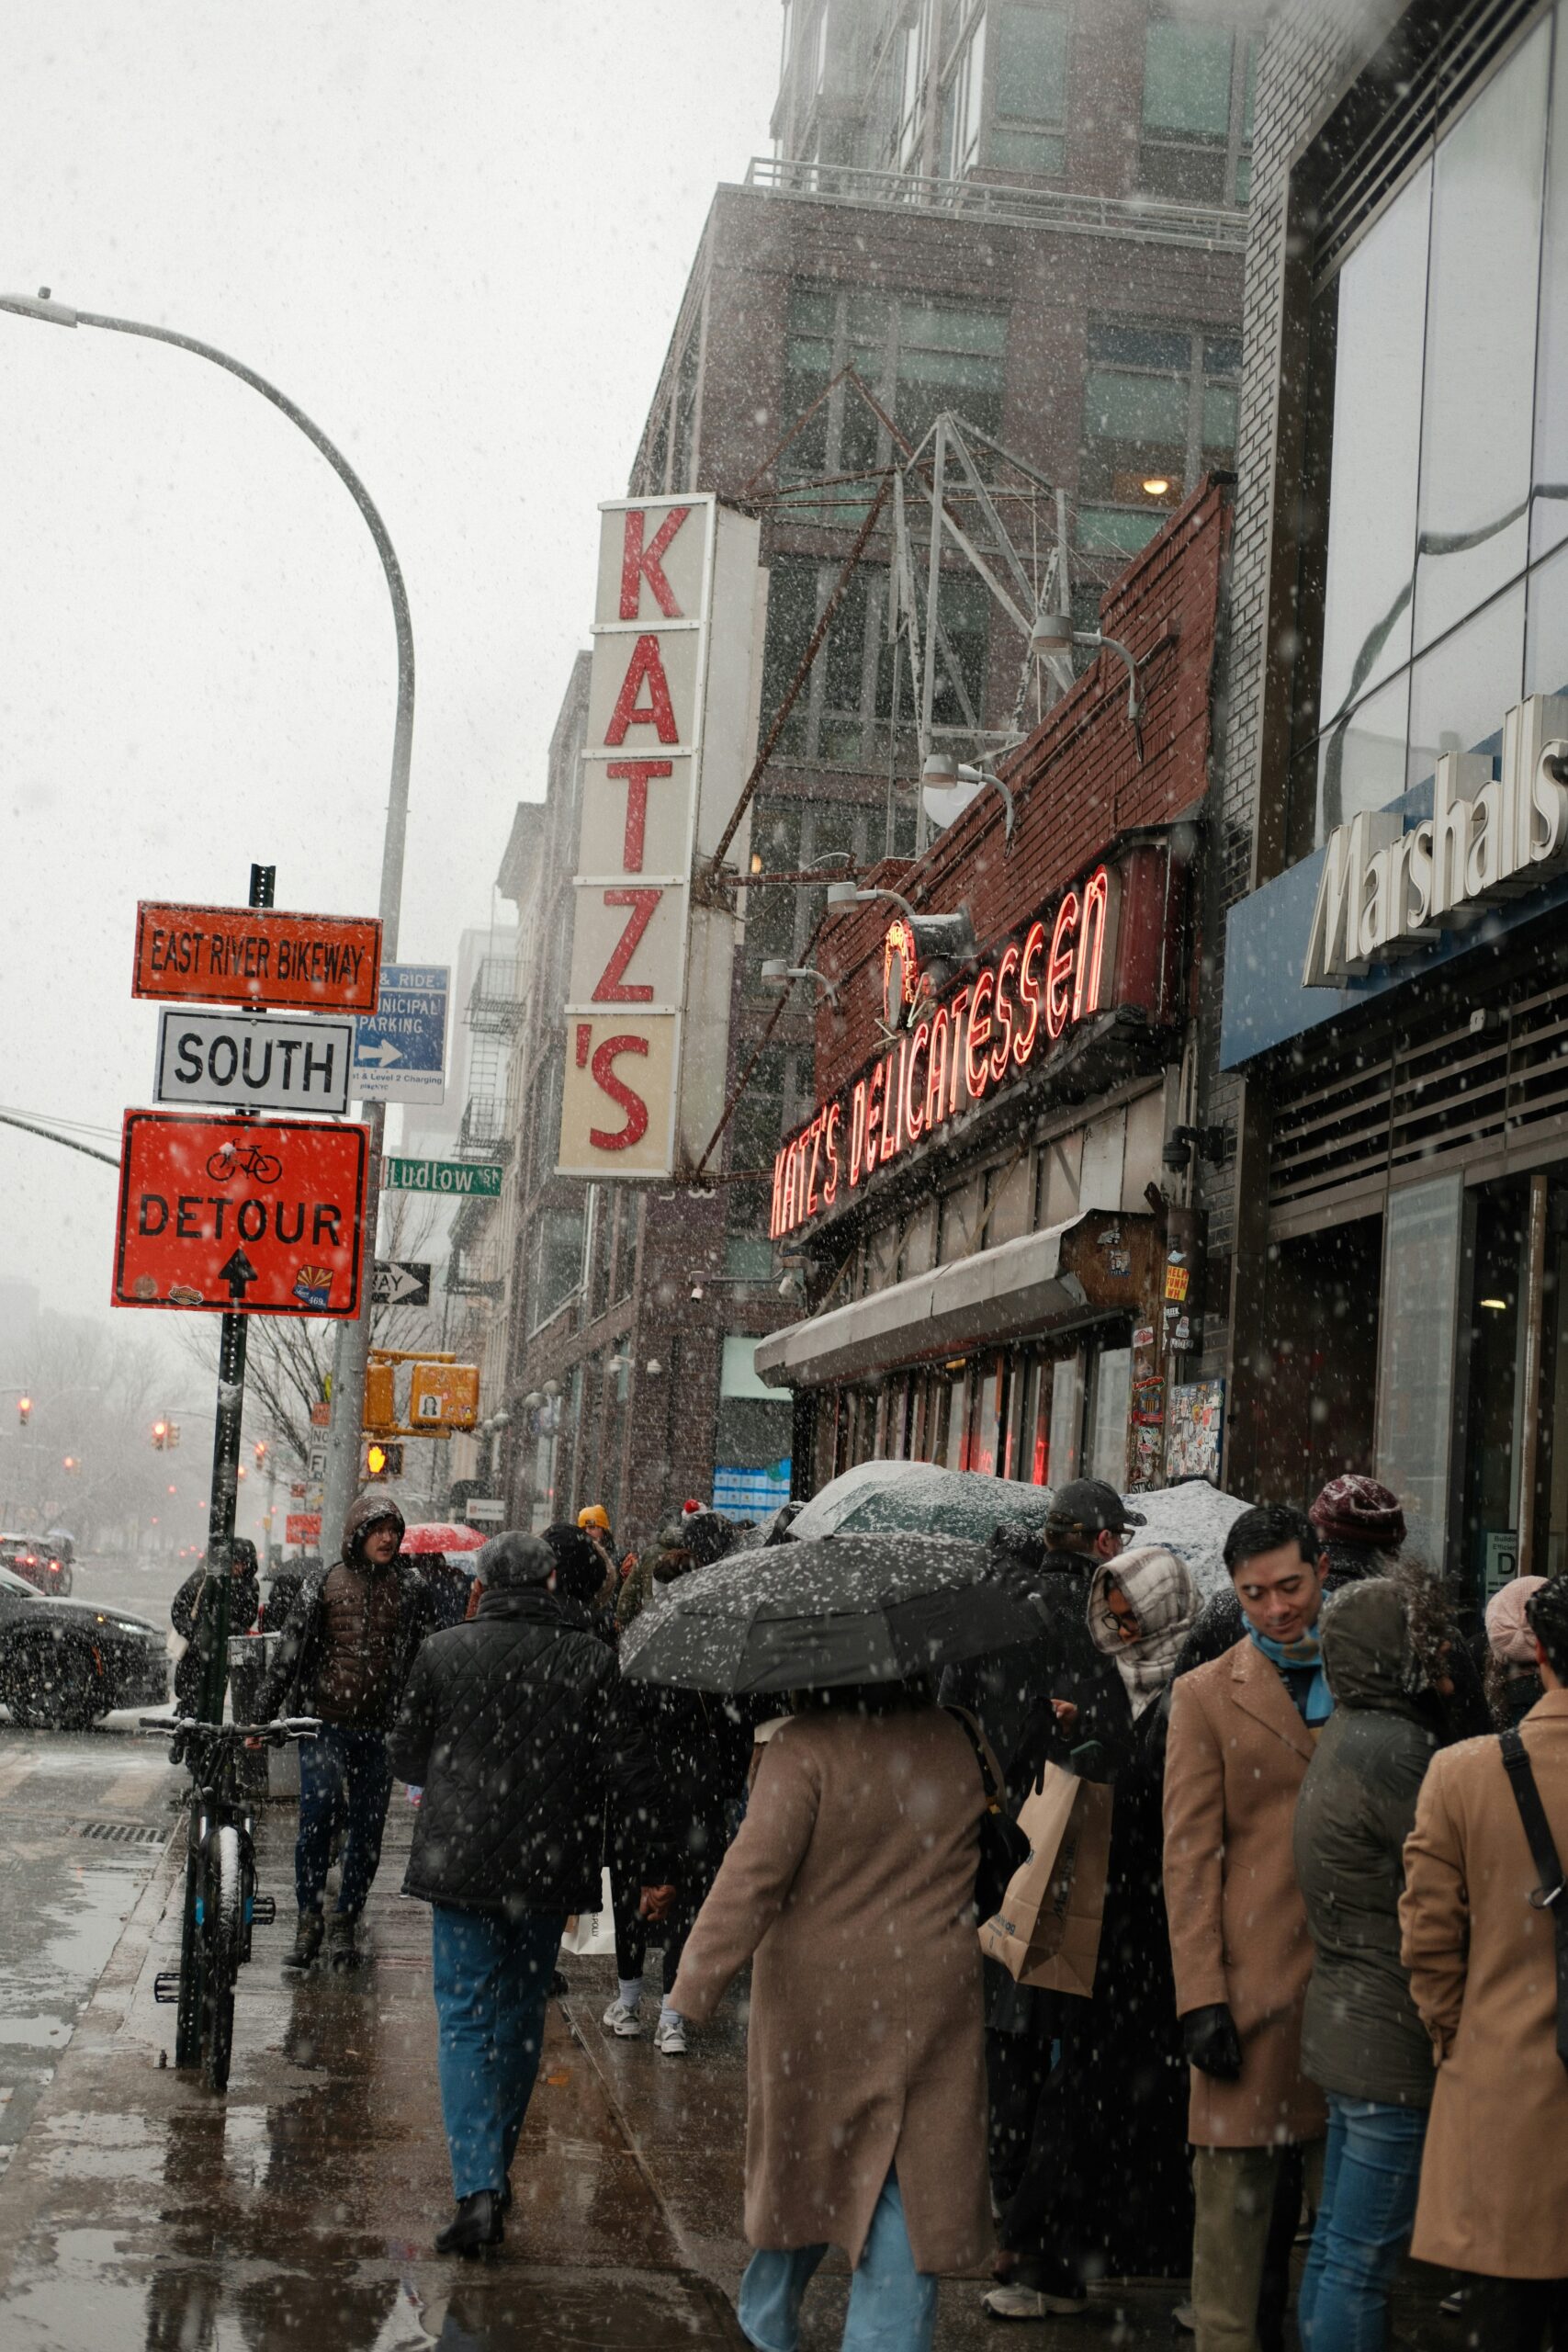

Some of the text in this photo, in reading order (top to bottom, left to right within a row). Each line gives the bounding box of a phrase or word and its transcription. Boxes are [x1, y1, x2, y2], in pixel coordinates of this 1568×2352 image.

[576, 507, 690, 1151] KATZ'S
[1302, 694, 1568, 989] Marshalls
[151, 930, 366, 986] EAST RIVER BIKEWAY
[399, 973, 435, 988] RIDE
[359, 1016, 423, 1034] PARKING
[378, 997, 441, 1015] NICIPAL
[174, 1033, 334, 1094] SOUTH
[370, 1073, 393, 1081] Level
[403, 1075, 443, 1085] Charging
[389, 1160, 499, 1192] Ludlow St
[770, 1103, 840, 1240] KATZ'S
[138, 1194, 341, 1247] DETOUR
